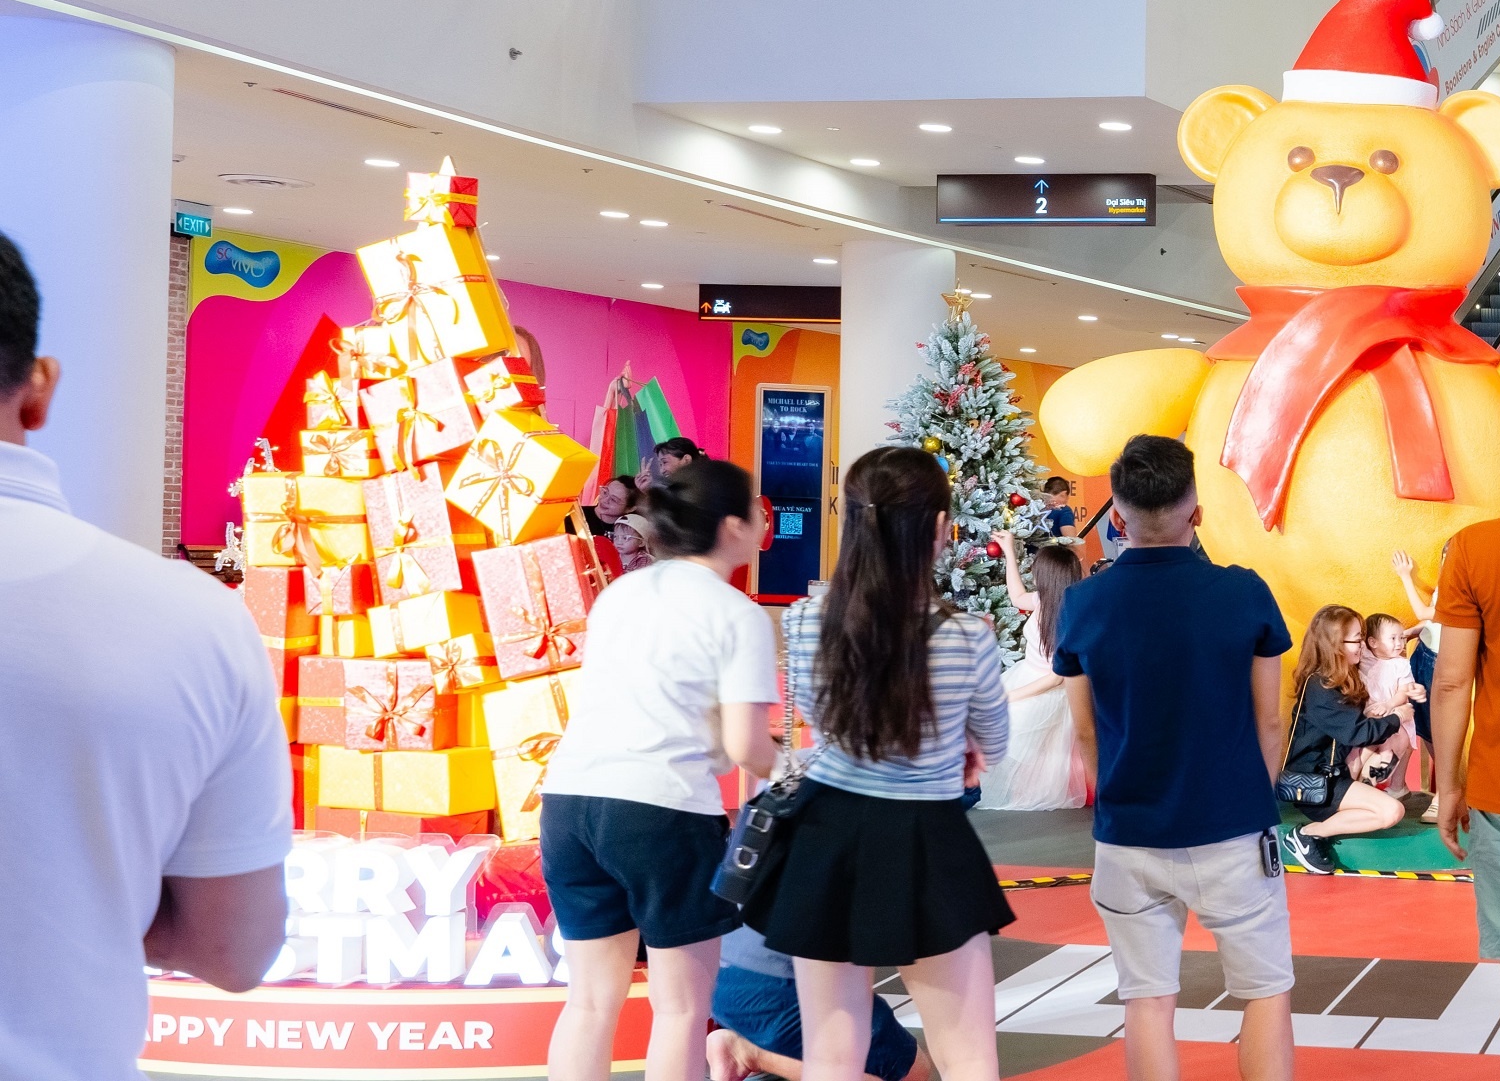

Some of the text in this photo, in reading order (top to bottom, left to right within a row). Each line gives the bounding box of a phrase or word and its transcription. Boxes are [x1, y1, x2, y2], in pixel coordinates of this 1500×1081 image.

[1445, 58, 1472, 96] Bookstore
[1478, 30, 1496, 58] English
[1036, 198, 1048, 214] 2
[1108, 207, 1146, 215] Hypermarket
[184, 218, 204, 234] EXIT
[216, 247, 232, 260] SC
[284, 845, 477, 917] RRY
[139, 1013, 494, 1050] PPY NEW YEAR
